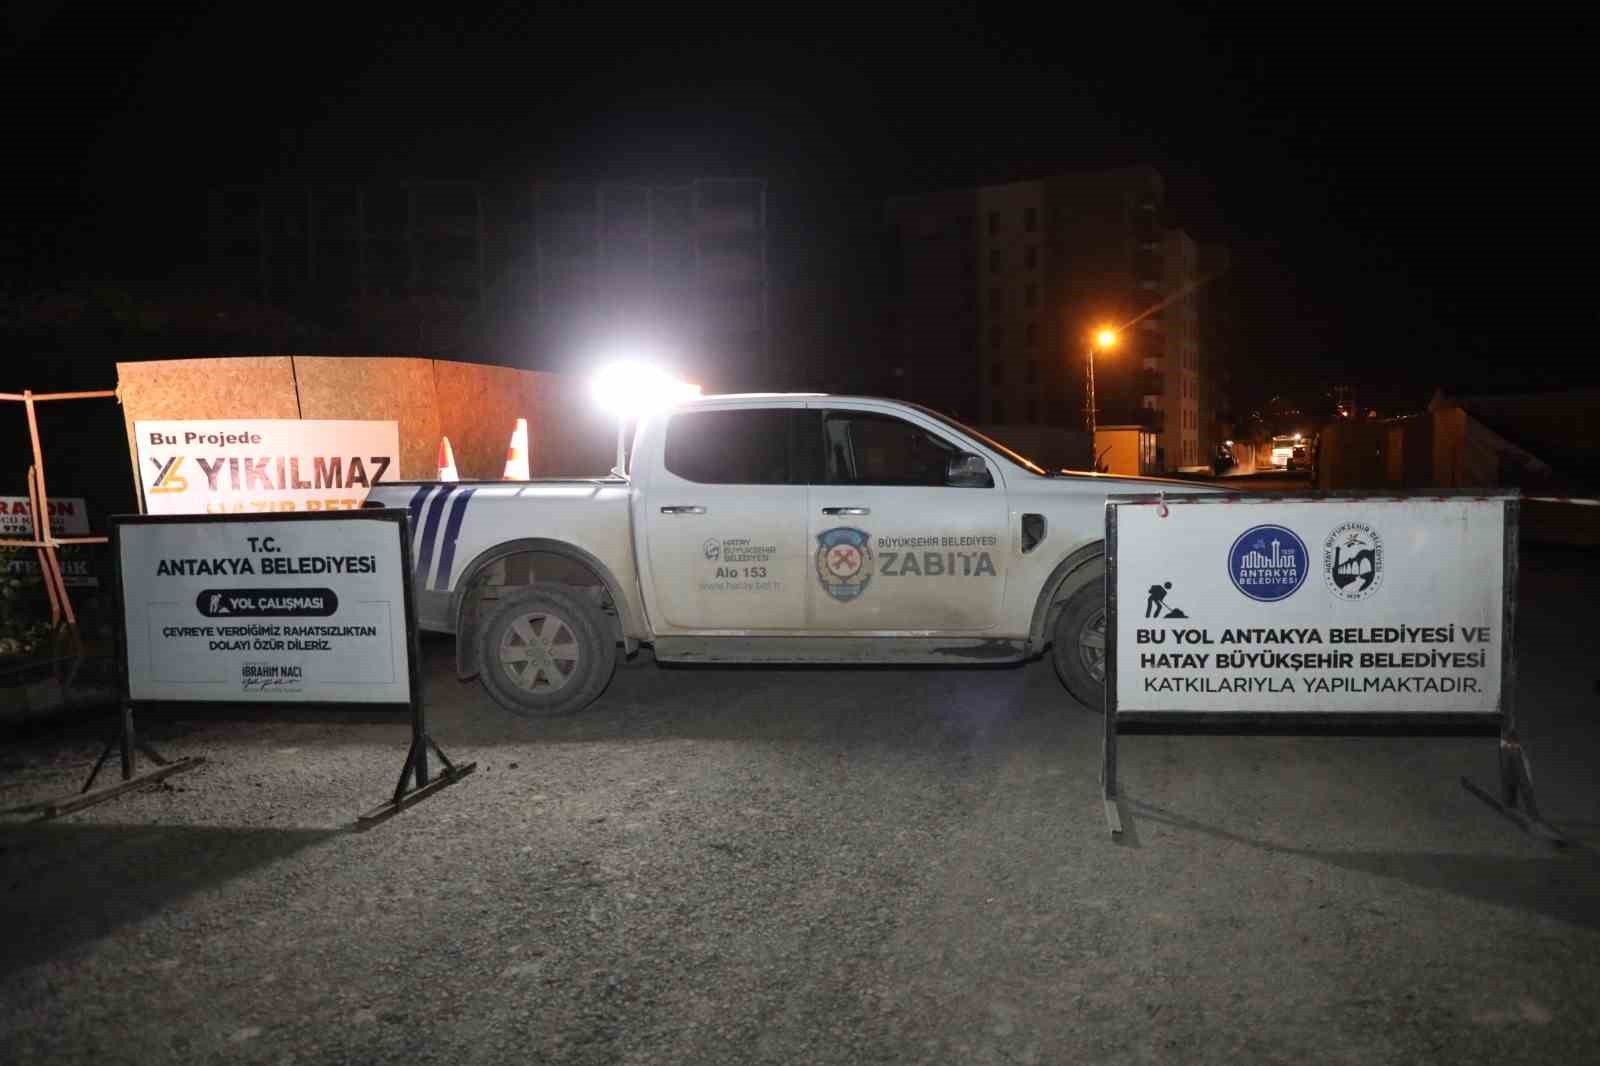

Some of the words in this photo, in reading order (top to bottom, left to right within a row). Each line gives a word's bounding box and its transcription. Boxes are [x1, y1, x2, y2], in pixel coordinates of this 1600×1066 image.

[149, 433, 177, 445] Bu
[184, 432, 262, 447] Projede
[196, 456, 391, 490] YIKILMAZ
[247, 536, 281, 553] T.C.
[157, 558, 255, 576] ANTAKYA
[261, 555, 377, 575] BELEDİYESİ
[715, 567, 738, 578] Alo
[743, 567, 767, 578] 153
[878, 551, 997, 577] ZABITA
[1240, 569, 1297, 578] ANTAKYA
[230, 598, 253, 609] YOL
[258, 597, 324, 612] ÇALIŞMASI
[162, 626, 214, 638] ÇEVREYE
[217, 625, 281, 637] VERDİĞİMİZ
[283, 626, 377, 637] RAHATSIZLIKTAN
[1136, 629, 1166, 644] BU
[1172, 629, 1215, 644] YOL
[1220, 629, 1322, 644] ANTAKYA
[1329, 624, 1455, 644] BELEDİYESİ
[1461, 627, 1491, 643] VE
[209, 640, 251, 651] DOLAYI
[253, 638, 285, 651] ÖZÜR
[287, 638, 332, 651] DİLERİZ.
[1140, 653, 1210, 669] HATAY
[1215, 649, 1354, 671] BÜYÜKŞEHİR
[1360, 649, 1486, 668] BELEDİYESİ
[1144, 677, 1295, 692] KATKILARIYLA
[1303, 676, 1483, 693] YAPILMAKTADIR.
